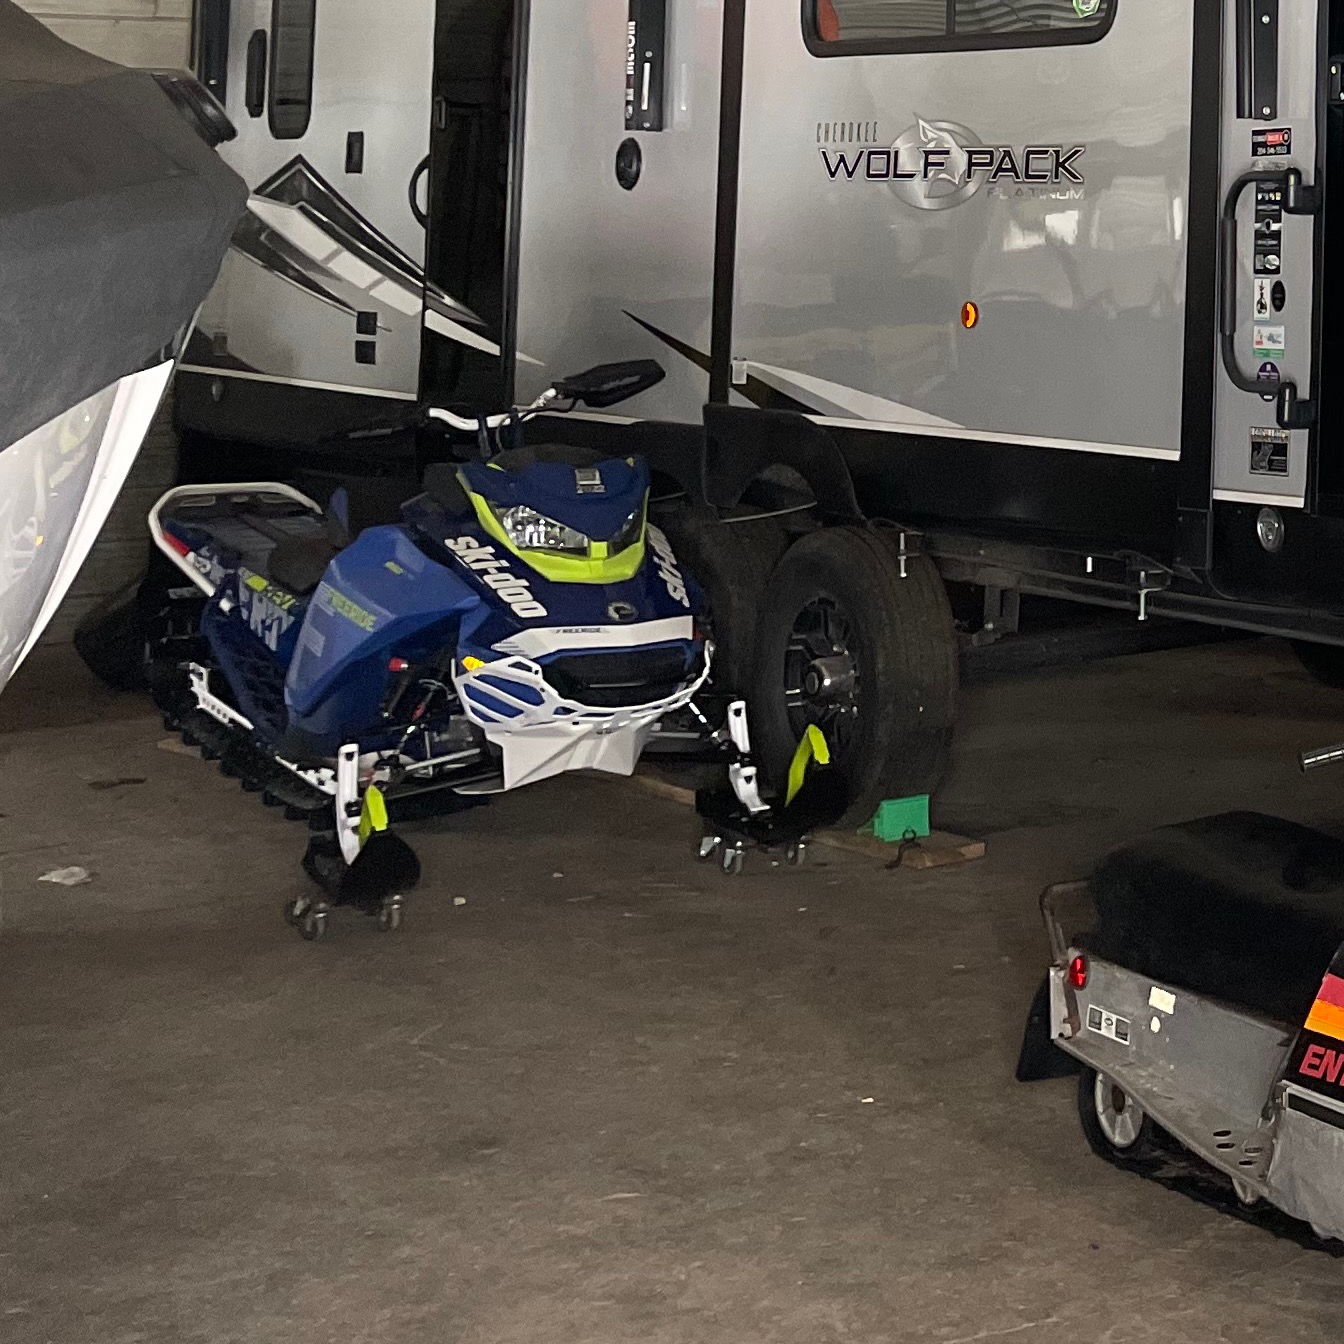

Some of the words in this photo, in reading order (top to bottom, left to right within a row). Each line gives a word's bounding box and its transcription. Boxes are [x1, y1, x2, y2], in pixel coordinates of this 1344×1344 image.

[815, 121, 879, 144] CHEROKEE
[818, 145, 952, 182] WOLF
[962, 144, 1087, 185] PACK
[986, 185, 1086, 201] PLATINUM
[444, 536, 548, 619] ski-doo
